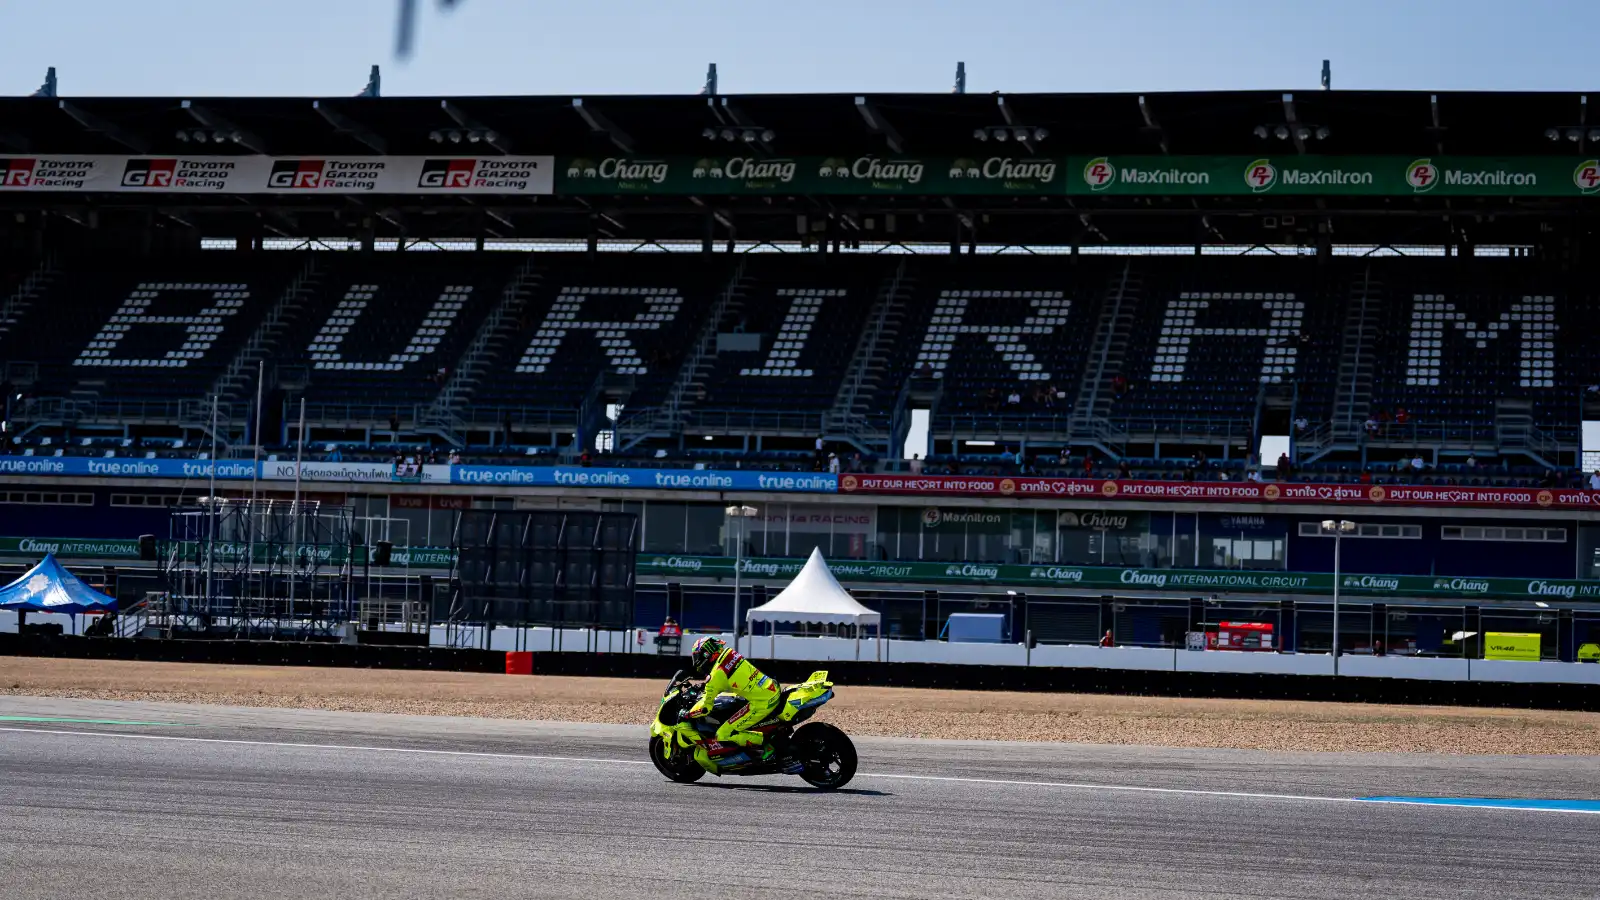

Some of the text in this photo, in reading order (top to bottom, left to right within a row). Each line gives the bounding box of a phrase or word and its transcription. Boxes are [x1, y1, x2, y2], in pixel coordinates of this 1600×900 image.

[40, 160, 93, 169] TOYOTA
[181, 160, 235, 169] TOYOTA
[328, 161, 385, 170] TOYOTA
[480, 161, 538, 170] TOYOTA
[599, 157, 668, 183] Chang
[725, 157, 796, 183] Chang
[852, 157, 924, 183] Chang
[982, 157, 1056, 183] Chang
[36, 169, 86, 178] GAZOO
[177, 169, 228, 178] GAZOO
[326, 170, 378, 179] GAZOO
[477, 170, 530, 179] GAZOO
[1121, 168, 1209, 184] Maxnitron
[1282, 169, 1373, 185] Maxnitron
[1444, 170, 1536, 186] Maxnitron
[34, 178, 84, 188] Racing
[175, 178, 225, 189] Racing
[323, 179, 375, 190] Racing
[474, 179, 527, 190] Racing
[72, 282, 1556, 388] BURIRAM
[28, 459, 64, 472] online
[88, 459, 159, 474] true online
[182, 461, 255, 476] true online
[458, 468, 534, 483] true online
[554, 470, 629, 485] true online
[655, 472, 732, 487] true online
[757, 474, 837, 489] true online
[862, 480, 882, 488] PUT
[883, 480, 903, 489] OUR
[944, 481, 965, 490] INTO
[968, 481, 994, 490] FOOD
[1123, 484, 1142, 493] PUT
[1144, 485, 1164, 494] OUR
[1207, 486, 1229, 496] INTO
[1232, 487, 1259, 497] FOOD
[440, 497, 462, 507] true
[1391, 490, 1412, 499] PUT
[1413, 491, 1433, 500] OUR
[1477, 492, 1500, 501] INTO
[1503, 493, 1530, 502] FOOD
[810, 515, 870, 524] RACING
[942, 511, 1001, 523] Maxnitron
[1079, 511, 1128, 528] Chang
[1230, 515, 1265, 526] YAMAHA
[19, 539, 138, 554] Chang INTERNATIONAL
[667, 556, 702, 571] Chang
[735, 559, 778, 577] Chang
[870, 566, 912, 576] CIRCUIT
[960, 564, 998, 579] Chang
[1047, 567, 1083, 582] Chang
[1120, 569, 1308, 588] Chang INTERNATIONAL CIRCUIT
[1361, 575, 1399, 591] Chang
[1450, 578, 1489, 593] Chang
[1528, 580, 1576, 599] Chang
